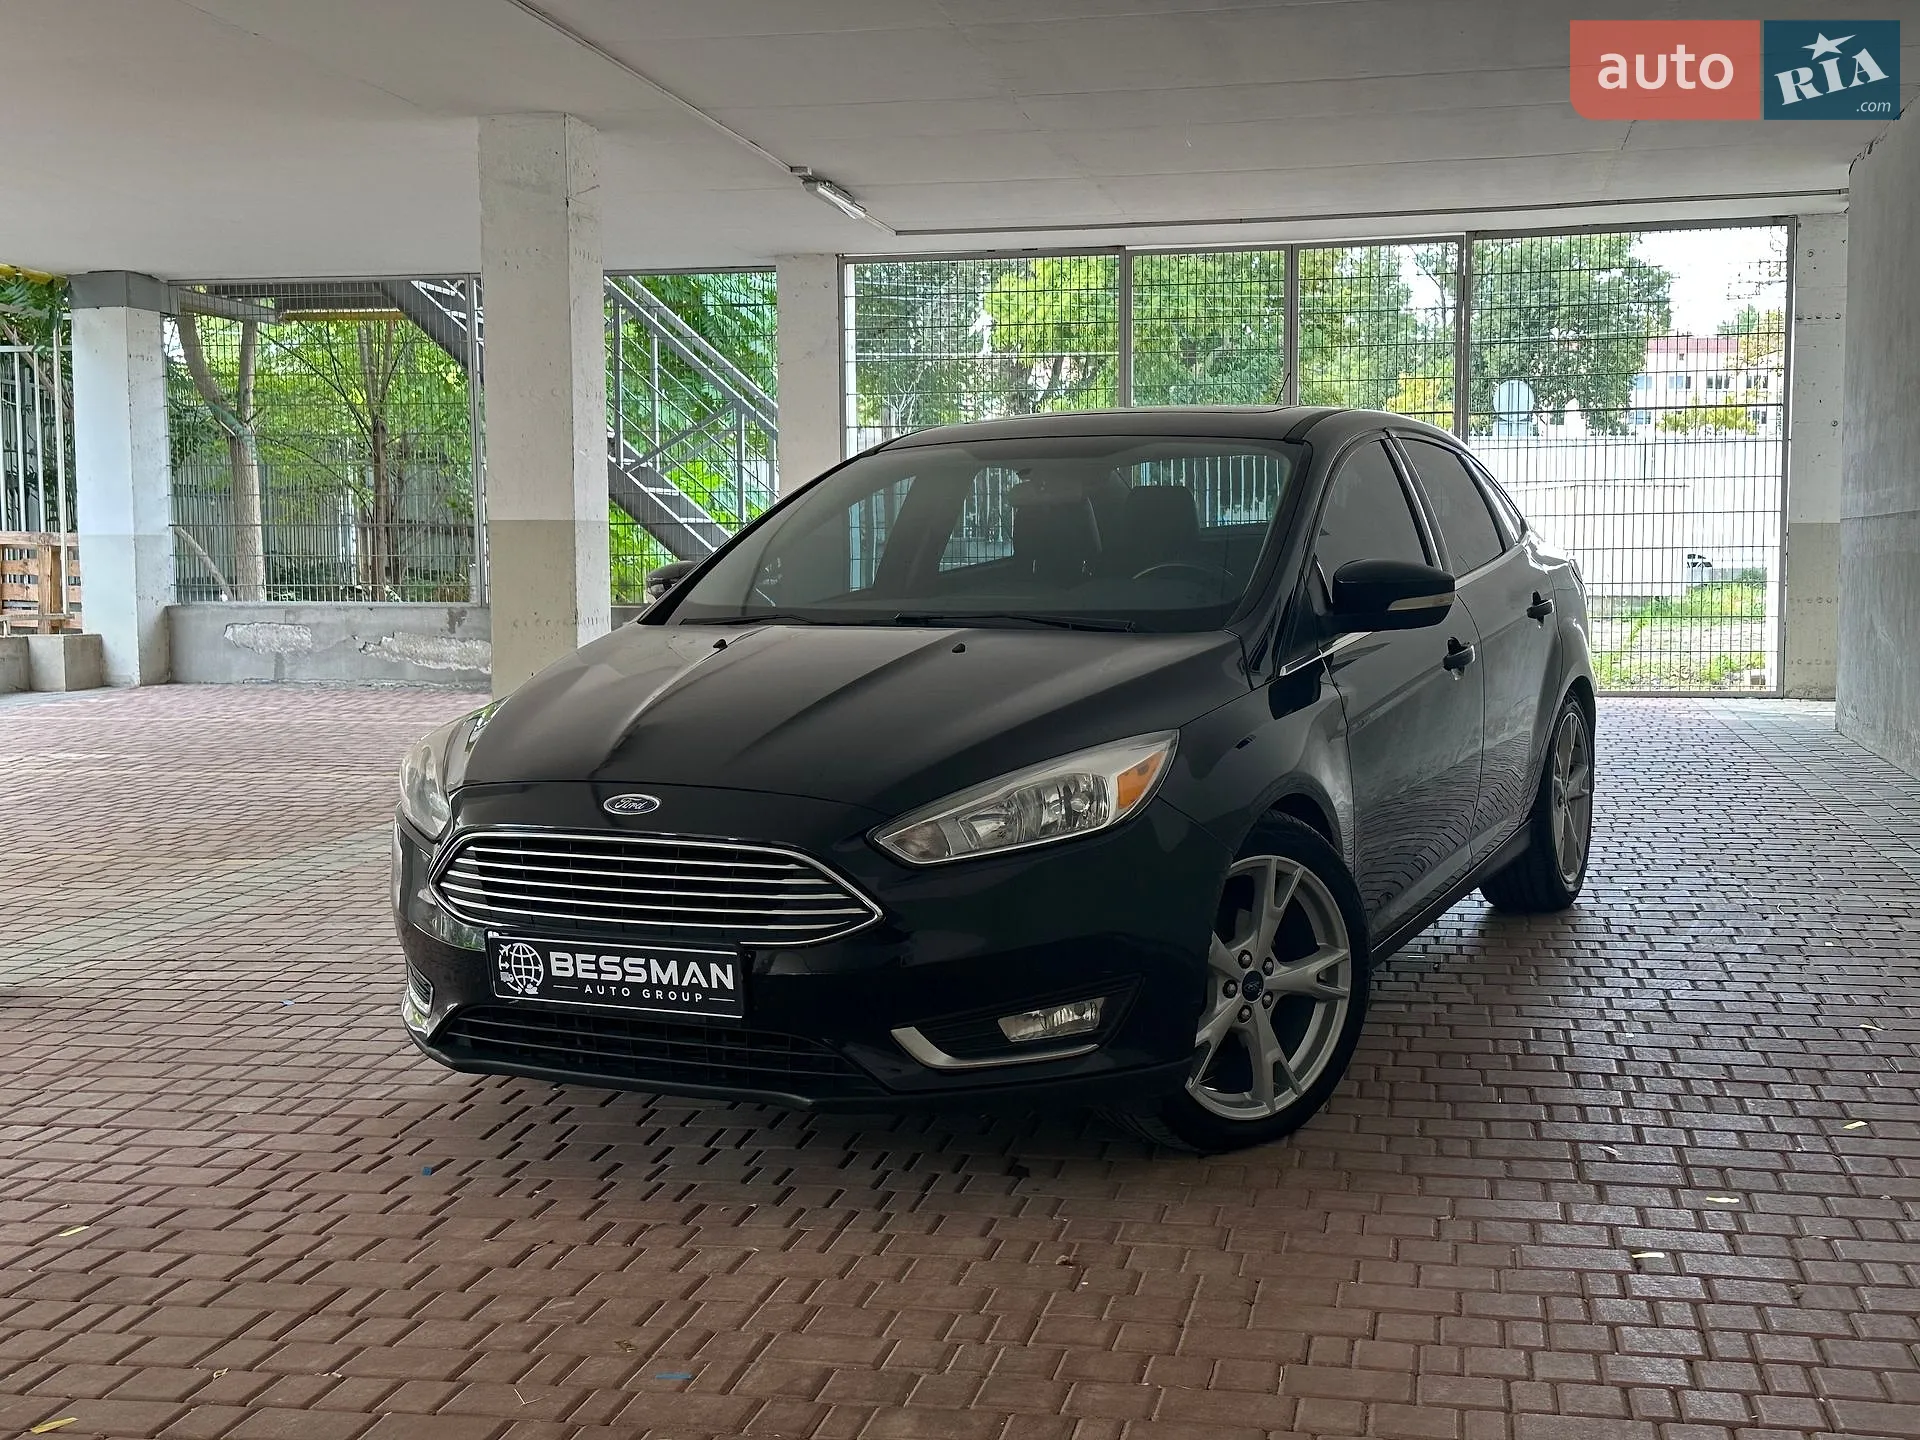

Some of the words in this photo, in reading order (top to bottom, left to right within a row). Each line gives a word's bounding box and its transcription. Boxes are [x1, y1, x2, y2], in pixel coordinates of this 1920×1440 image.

[614, 797, 648, 810] Ford
[549, 951, 735, 990] BESSMAN
[584, 984, 630, 997] AUTO
[642, 990, 703, 1003] GROUP
